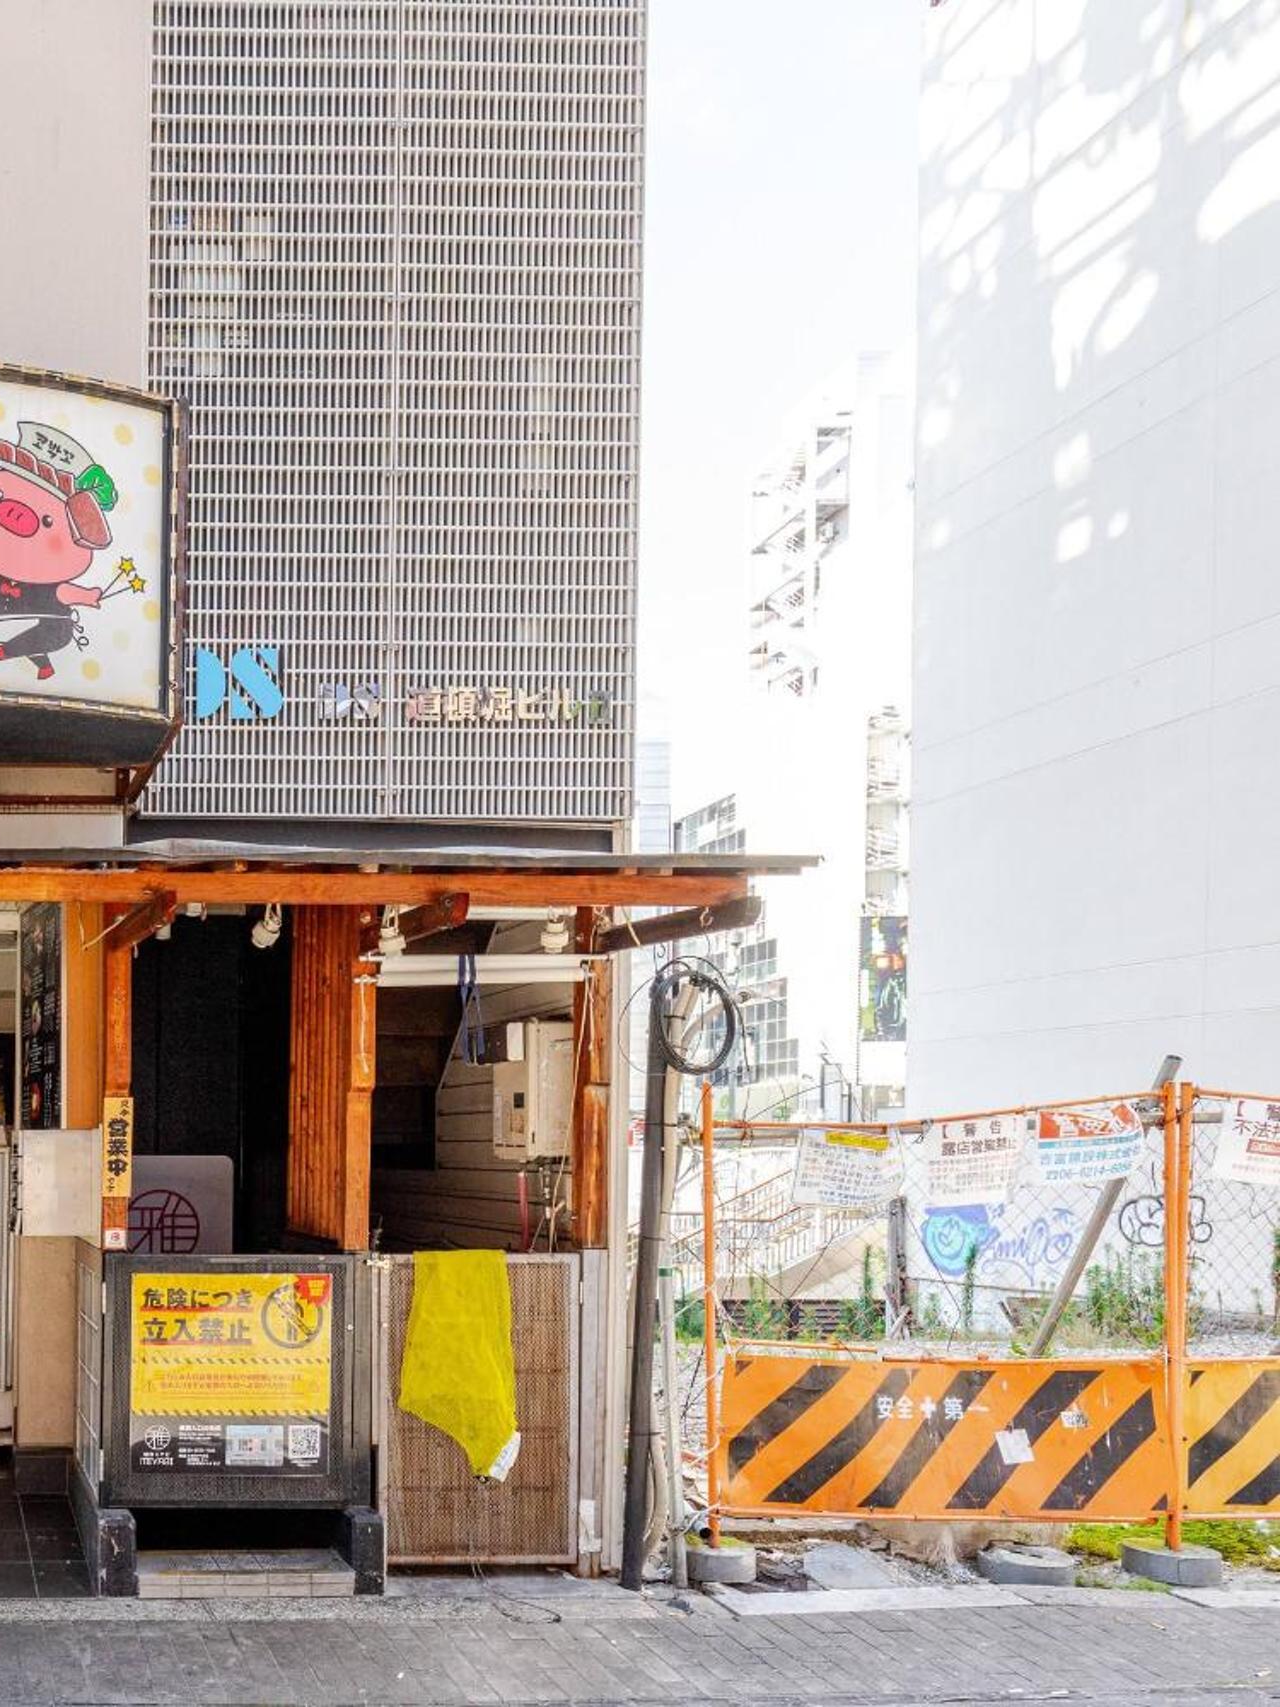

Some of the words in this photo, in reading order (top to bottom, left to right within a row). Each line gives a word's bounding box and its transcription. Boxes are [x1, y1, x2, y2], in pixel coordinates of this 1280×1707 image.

[195, 645, 284, 720] DS
[107, 1117, 129, 1177] 営業中
[142, 1288, 254, 1308] 危険につき
[142, 1317, 253, 1343] 立入禁止
